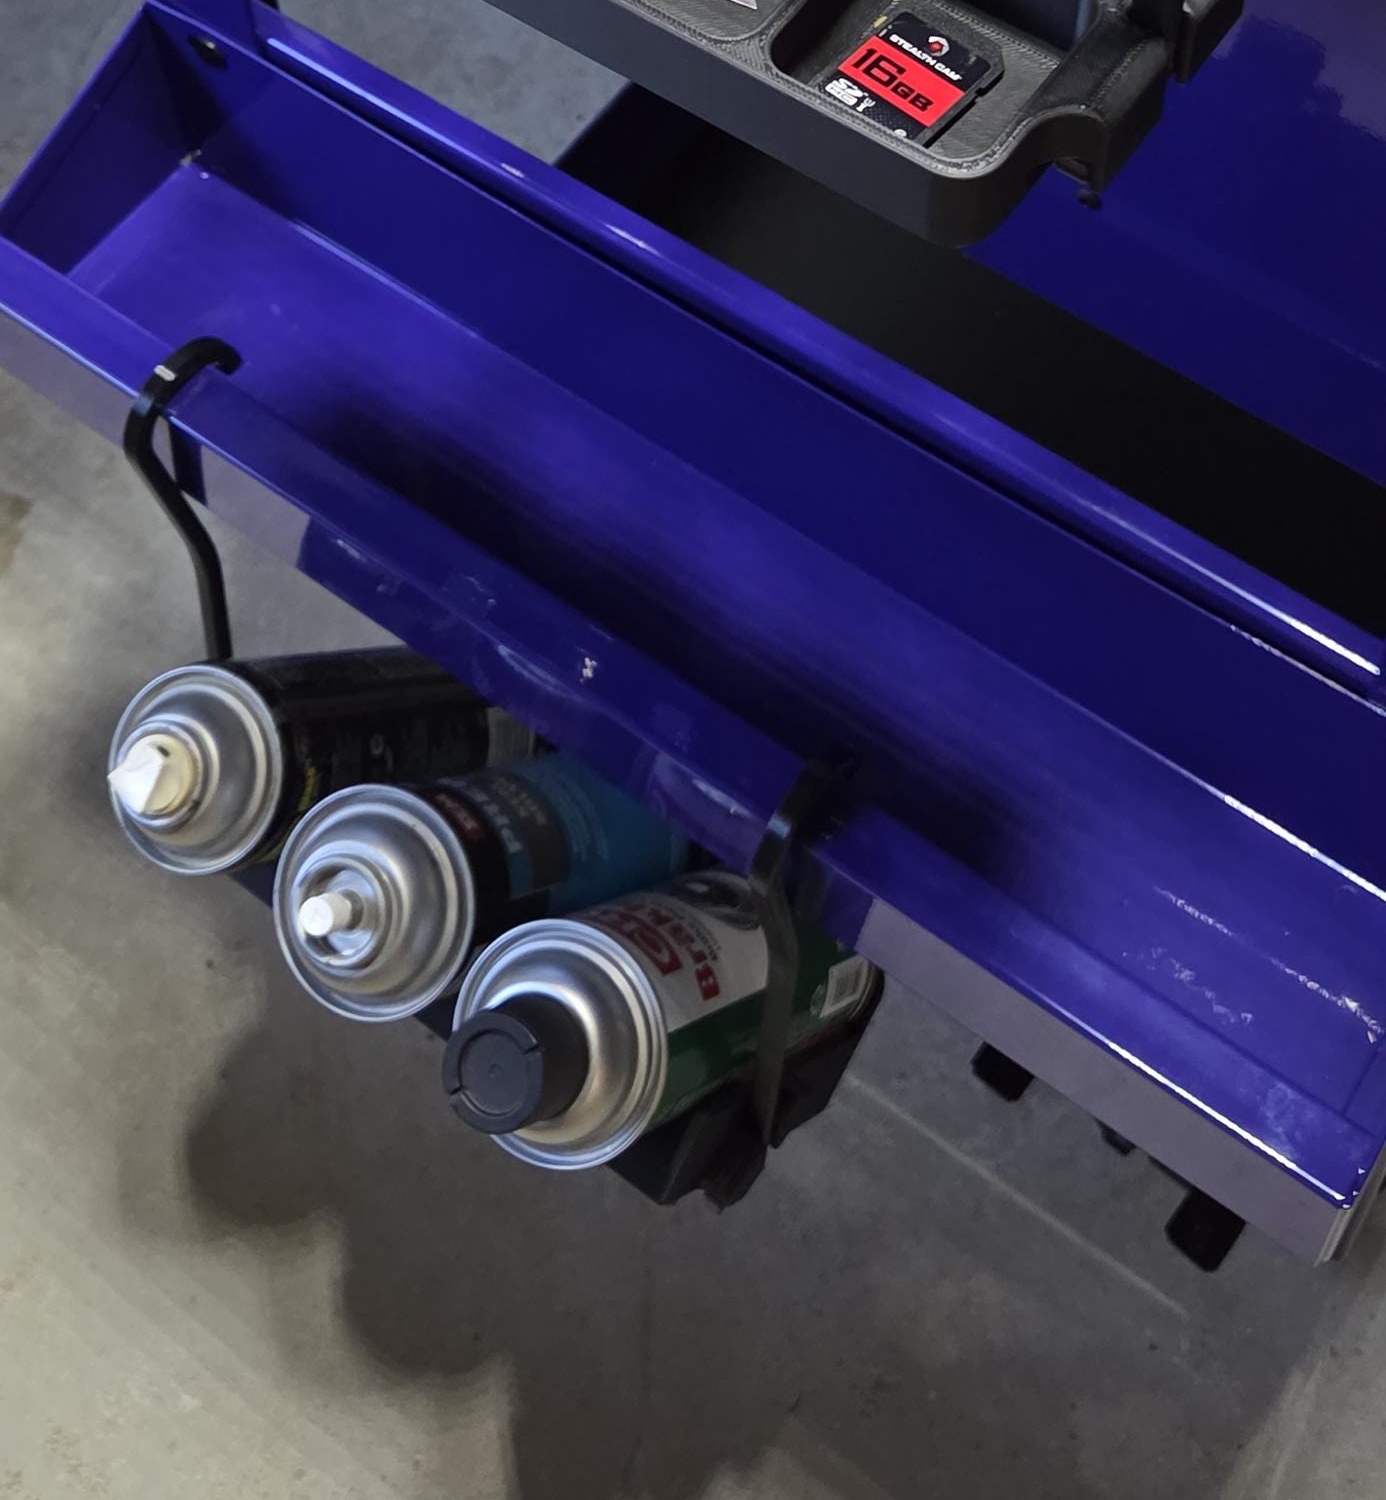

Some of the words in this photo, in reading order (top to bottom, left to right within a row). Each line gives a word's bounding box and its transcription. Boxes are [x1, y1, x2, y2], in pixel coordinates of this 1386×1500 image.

[852, 47, 934, 113] 16GB
[889, 33, 936, 68] STEALTH
[934, 61, 962, 81] CAM
